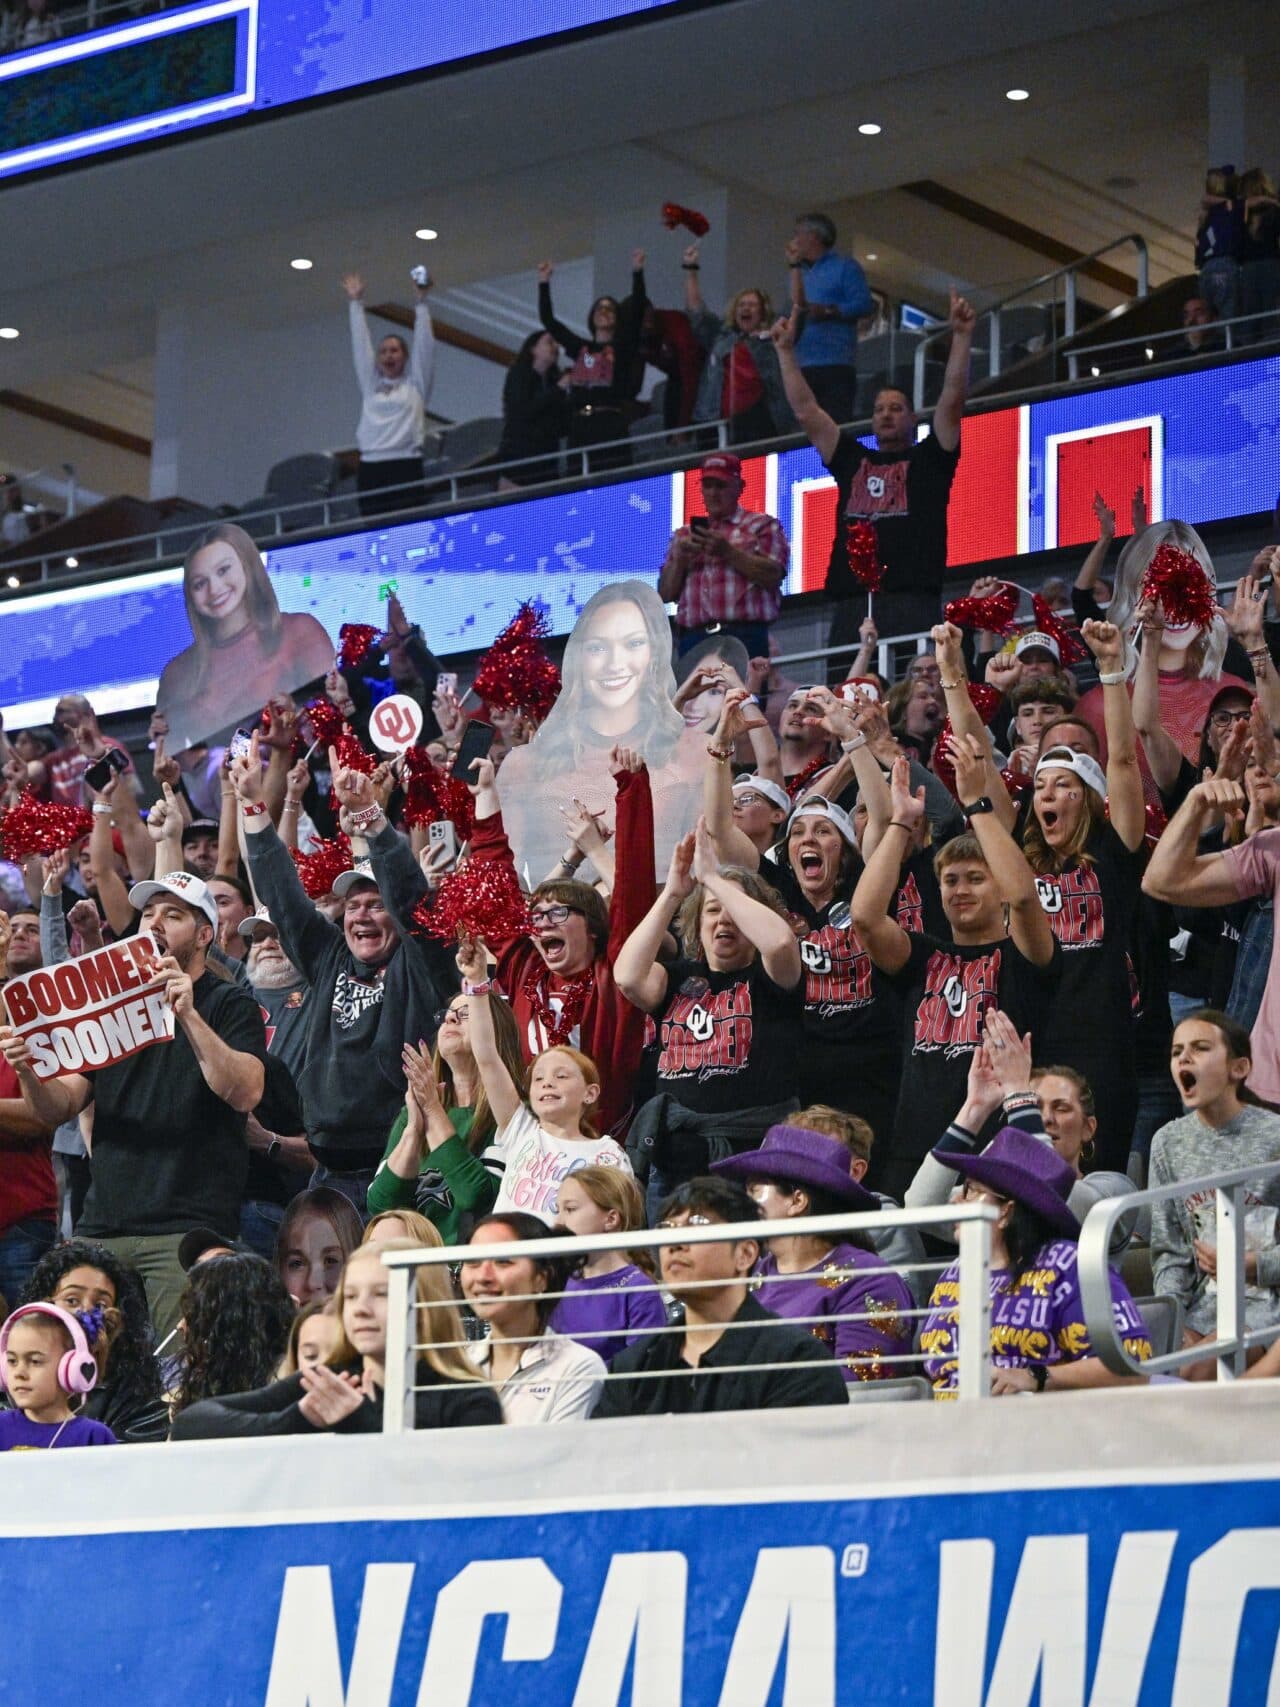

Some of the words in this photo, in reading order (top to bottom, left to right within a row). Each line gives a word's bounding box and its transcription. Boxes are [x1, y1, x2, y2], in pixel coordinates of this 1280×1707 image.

[375, 702, 416, 744] OU
[4, 936, 156, 1027] BOOMER
[24, 991, 175, 1078] SOONER
[996, 1298, 1049, 1328] LSU
